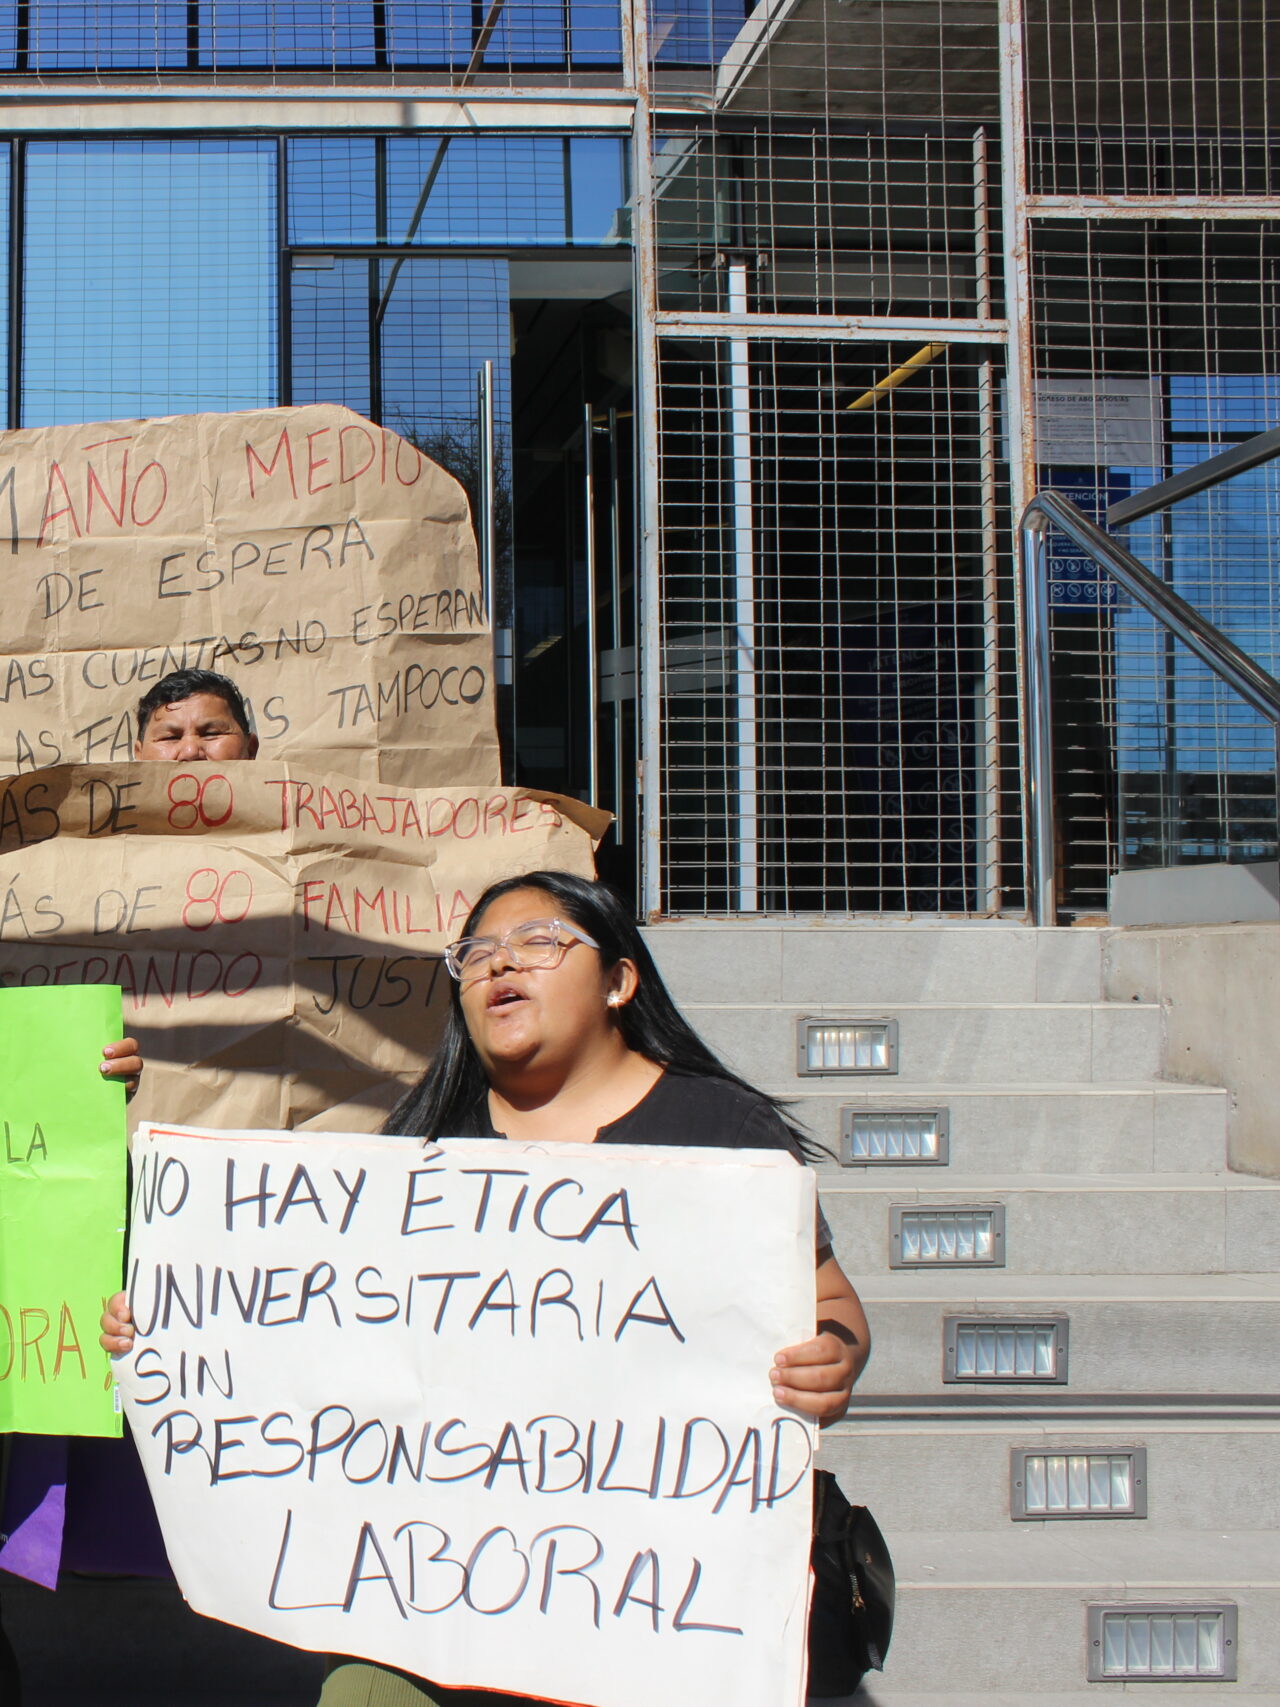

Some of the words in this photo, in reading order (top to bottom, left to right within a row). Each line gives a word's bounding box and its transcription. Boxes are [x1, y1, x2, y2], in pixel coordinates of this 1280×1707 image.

[38, 436, 169, 548] AÑO
[245, 425, 423, 499] MEDIO
[37, 569, 105, 620] DE
[158, 517, 376, 600] ESPERA
[81, 631, 265, 690] CUENTAS
[275, 620, 328, 661] NO
[351, 588, 484, 646] ESPERAN
[327, 663, 486, 729] TAMPOCO
[83, 780, 142, 838] DE
[166, 773, 235, 832] 80
[264, 779, 563, 841] TRABAJADORES
[92, 885, 163, 936] DE
[181, 868, 254, 933] 80
[293, 879, 475, 935] FAMILIA
[308, 954, 446, 1015] JUST
[3, 1121, 49, 1163] LA
[134, 1151, 190, 1224] NO
[225, 1157, 367, 1235] HAY
[400, 1149, 640, 1251] ÉTICA
[129, 1257, 686, 1344] UNIVERSITARIA
[133, 1348, 234, 1406] SIN
[151, 1404, 812, 1515] RESPONSABILIDAD
[267, 1508, 744, 1637] LABORAL
